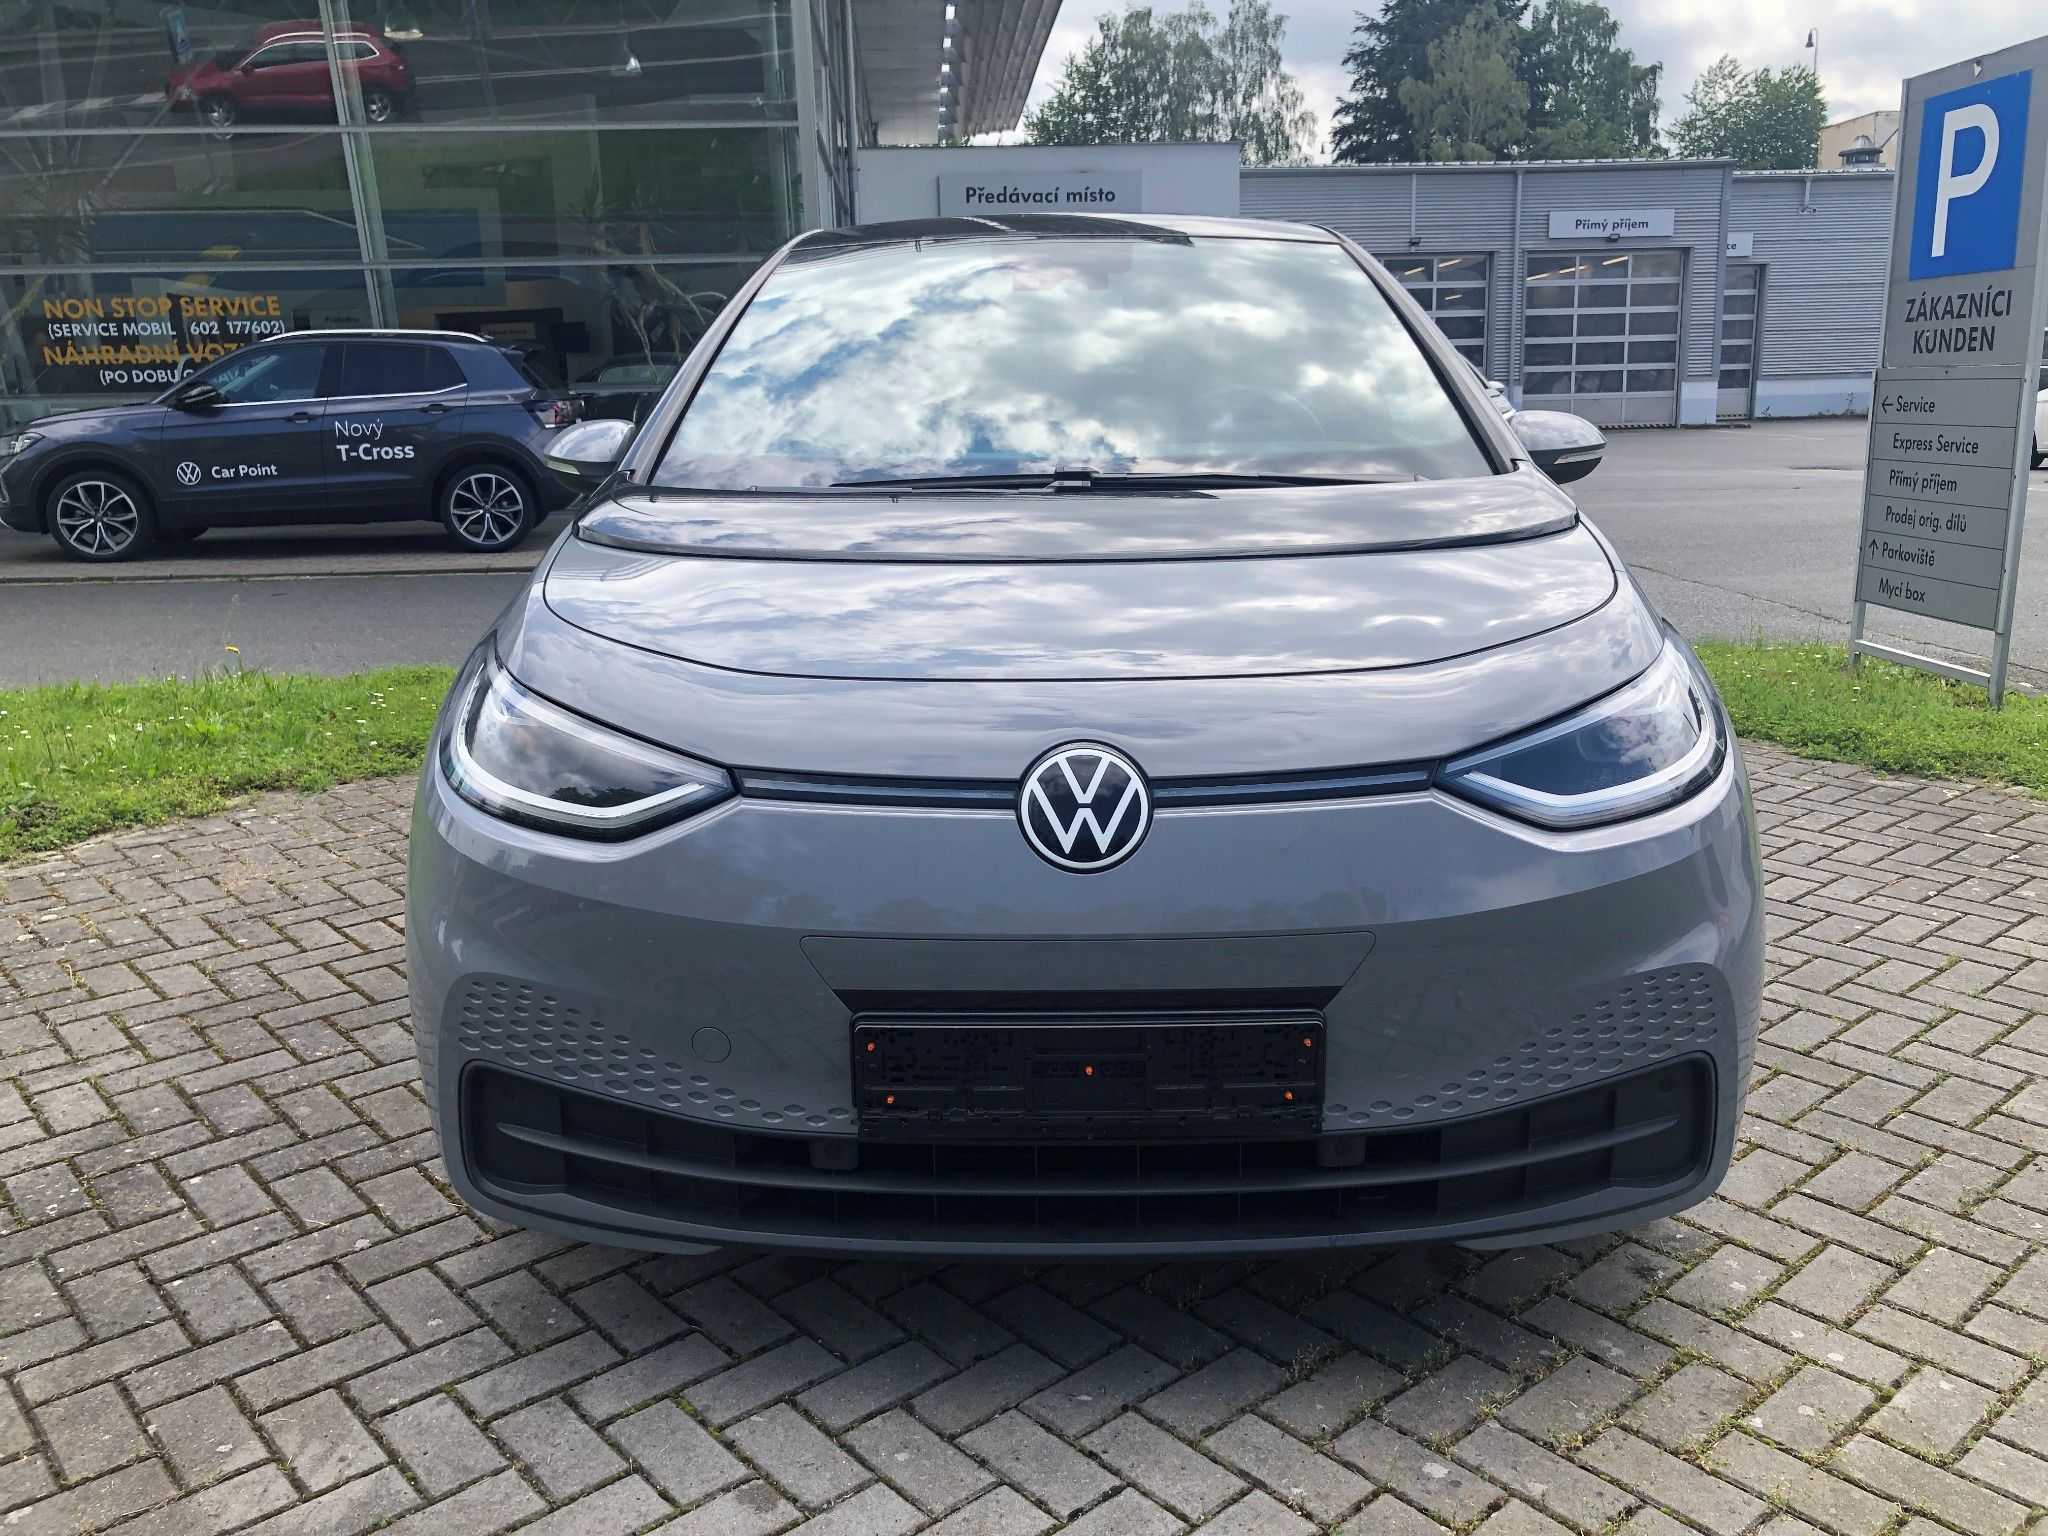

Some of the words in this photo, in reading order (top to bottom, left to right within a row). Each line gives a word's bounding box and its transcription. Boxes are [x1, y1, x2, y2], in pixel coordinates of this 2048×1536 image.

[1931, 103, 1999, 257] P
[965, 186, 1058, 204] Předávací
[1066, 187, 1116, 203] místo
[1575, 218, 1608, 232] Přímý
[1612, 218, 1649, 231] příjem
[43, 299, 105, 319] NON
[111, 298, 172, 318] STOP
[180, 296, 281, 316] SERVICE
[1905, 285, 2013, 322] ZÁKAZNÍCI
[48, 323, 118, 339] (SERVICE
[123, 321, 176, 336] MOBIL
[190, 321, 219, 335] 602
[226, 320, 286, 335] 177602)
[43, 340, 180, 366] NÁHRADNÍ
[99, 371, 128, 386] (PO
[1896, 395, 1935, 413] Service
[335, 418, 384, 440] Nový
[336, 443, 415, 462] T-Cross
[1893, 433, 1933, 454] Express
[1936, 434, 1979, 454] Service
[211, 466, 236, 479] Car
[239, 464, 278, 477] Point
[1889, 469, 1919, 493] Přímý
[1921, 473, 1957, 494] příjem
[1885, 505, 1917, 530] Prodej
[1918, 512, 1942, 533] orig.
[1945, 513, 1967, 533] dílů
[1881, 541, 1935, 567] Parkoviště
[1905, 581, 1926, 603] box
